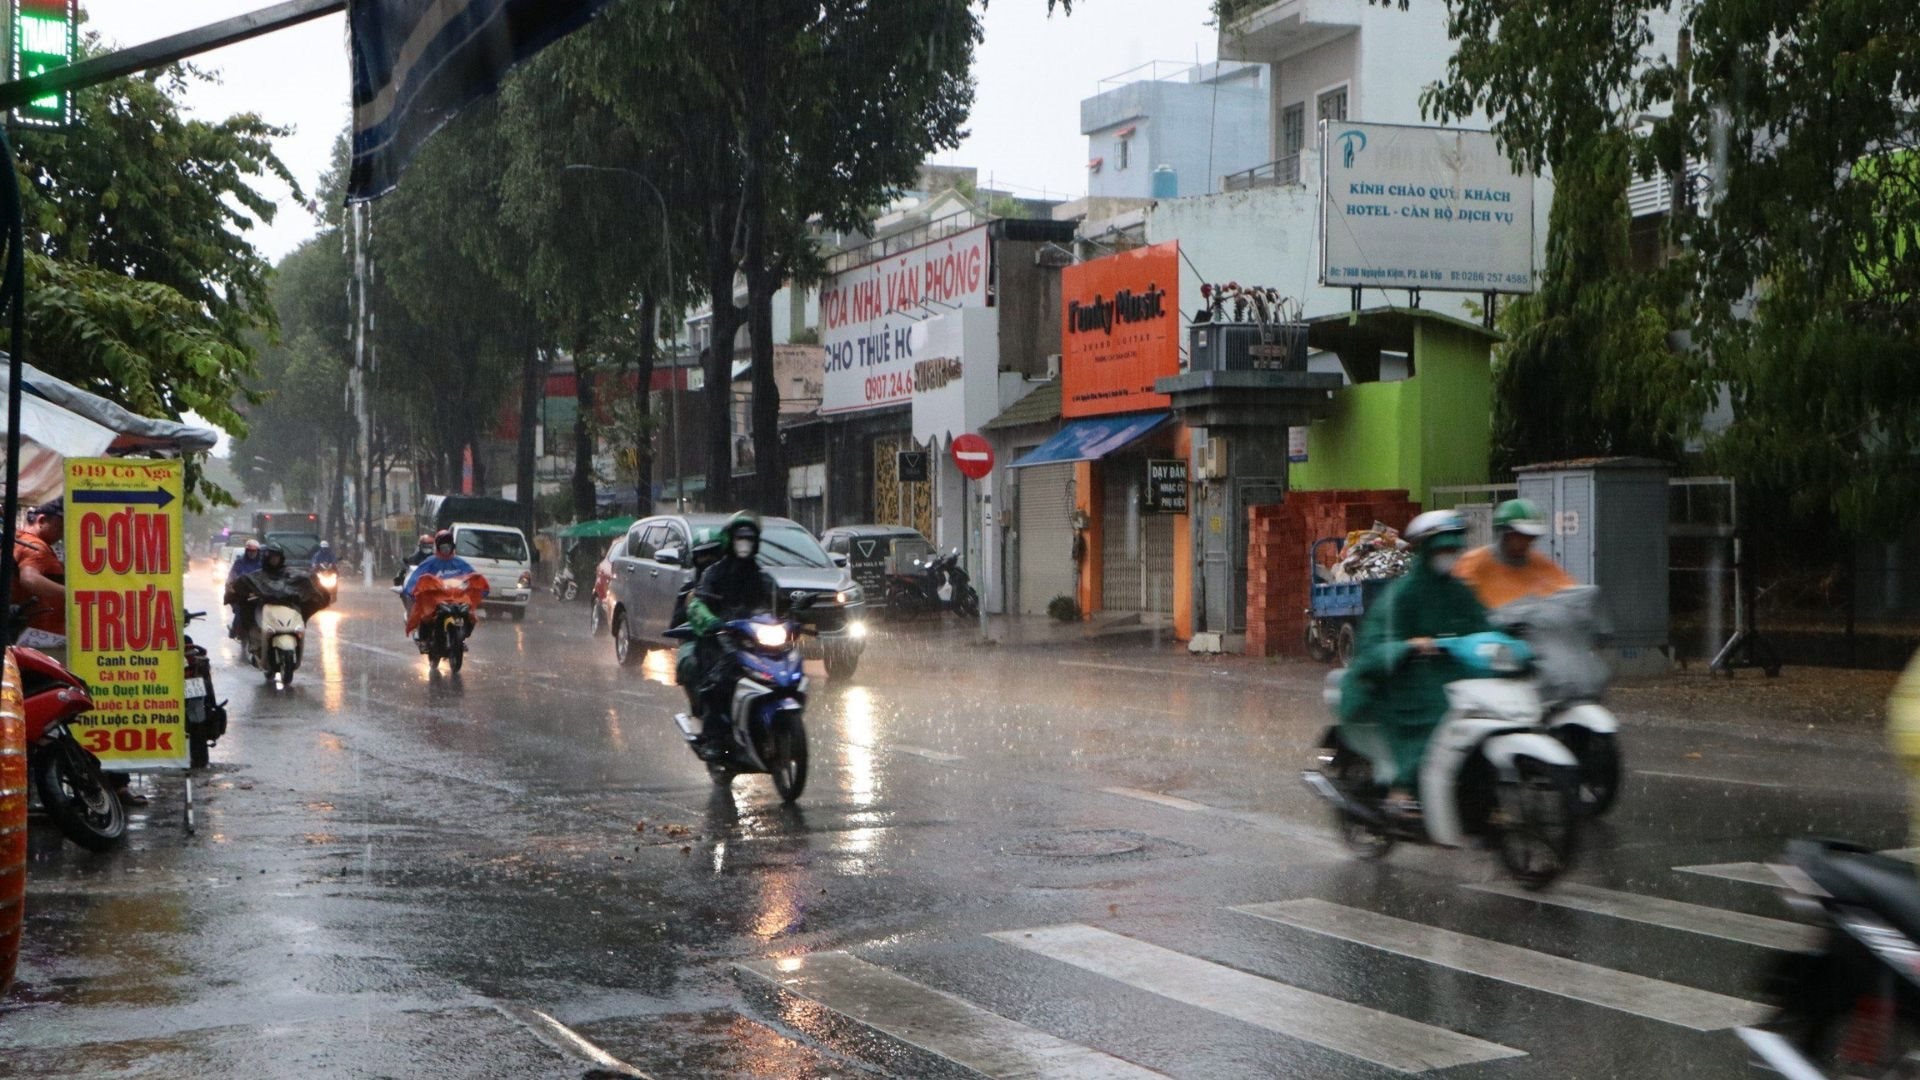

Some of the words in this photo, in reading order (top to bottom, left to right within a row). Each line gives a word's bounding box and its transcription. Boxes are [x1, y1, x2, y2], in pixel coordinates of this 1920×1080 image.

[1350, 181, 1384, 195] KÍNH
[1388, 183, 1425, 197] CHÀO
[1464, 187, 1511, 202] KHÁCH
[1346, 204, 1390, 216] HOTEL
[1459, 209, 1491, 223] DỊCH
[1495, 211, 1513, 226] VỤ
[852, 264, 882, 323] NHÀ
[887, 259, 919, 312] VĂN
[925, 242, 981, 304] PHÒNG
[1115, 283, 1166, 325] Music
[824, 340, 853, 373] CHO
[858, 324, 890, 366] THUÊ
[79, 506, 171, 575] CƠM
[74, 584, 179, 651] TRƯA
[97, 655, 126, 666] Canh
[130, 655, 159, 666] Chua
[99, 670, 114, 681] Cá
[118, 670, 140, 681] Kho
[113, 684, 139, 697] Quẹt
[127, 699, 140, 710] Lá
[144, 700, 179, 710] Chanh
[102, 714, 128, 727] Luộc
[82, 728, 174, 752] 30k
